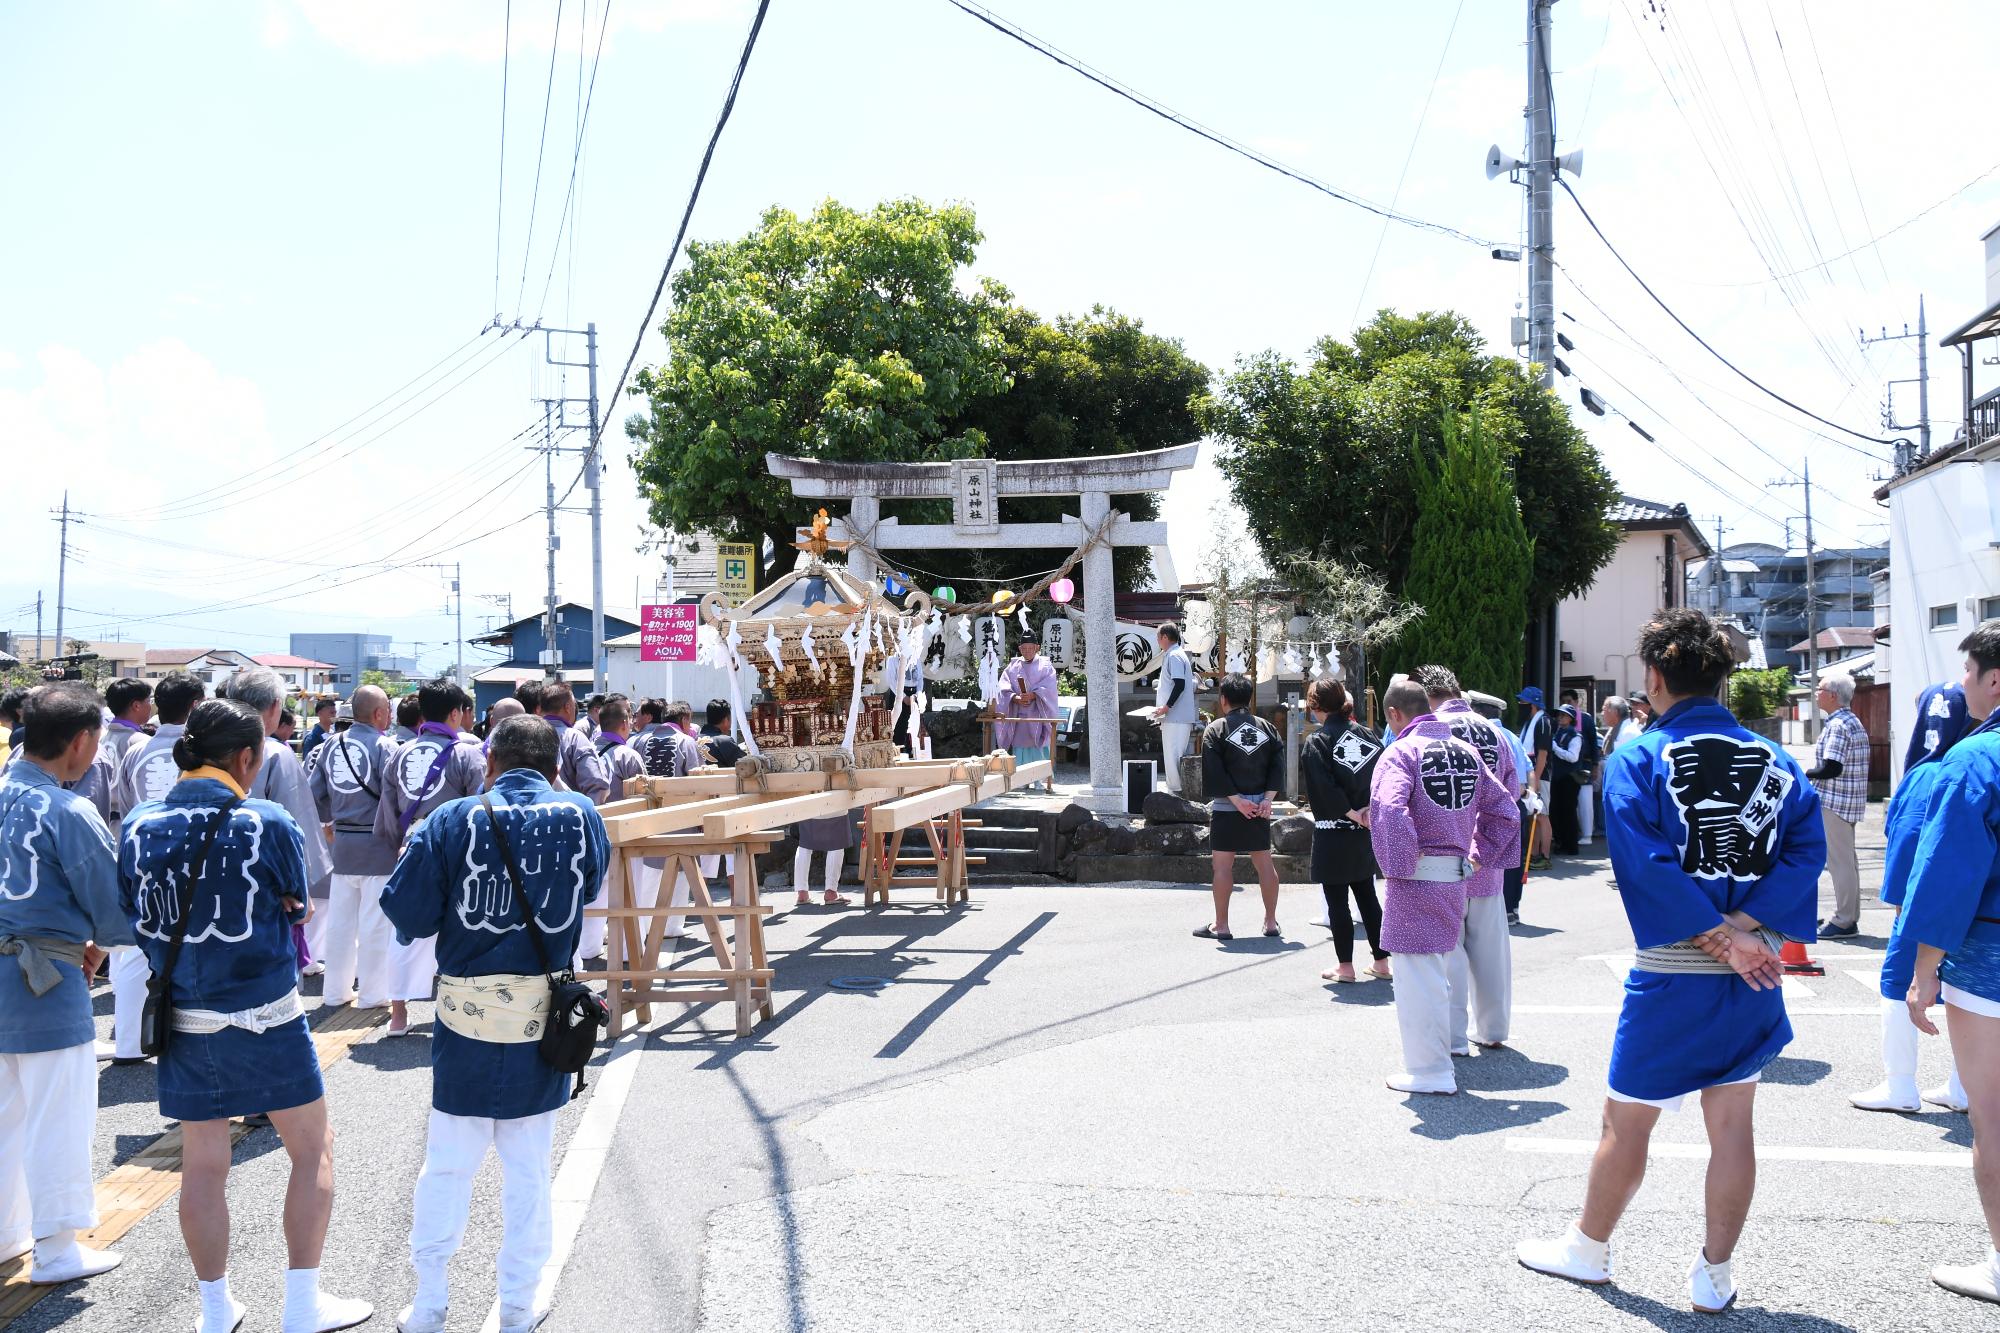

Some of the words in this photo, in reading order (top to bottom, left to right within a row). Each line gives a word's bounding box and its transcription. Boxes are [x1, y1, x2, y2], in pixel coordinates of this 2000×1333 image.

[967, 475, 983, 520] 原山神社
[718, 545, 753, 556] 避難場所
[652, 606, 686, 619] 美容室
[654, 646, 684, 656] AQUA
[1049, 623, 1064, 664] 原山神社
[1420, 740, 1480, 812] 神明
[1744, 773, 1784, 827] 甲州
